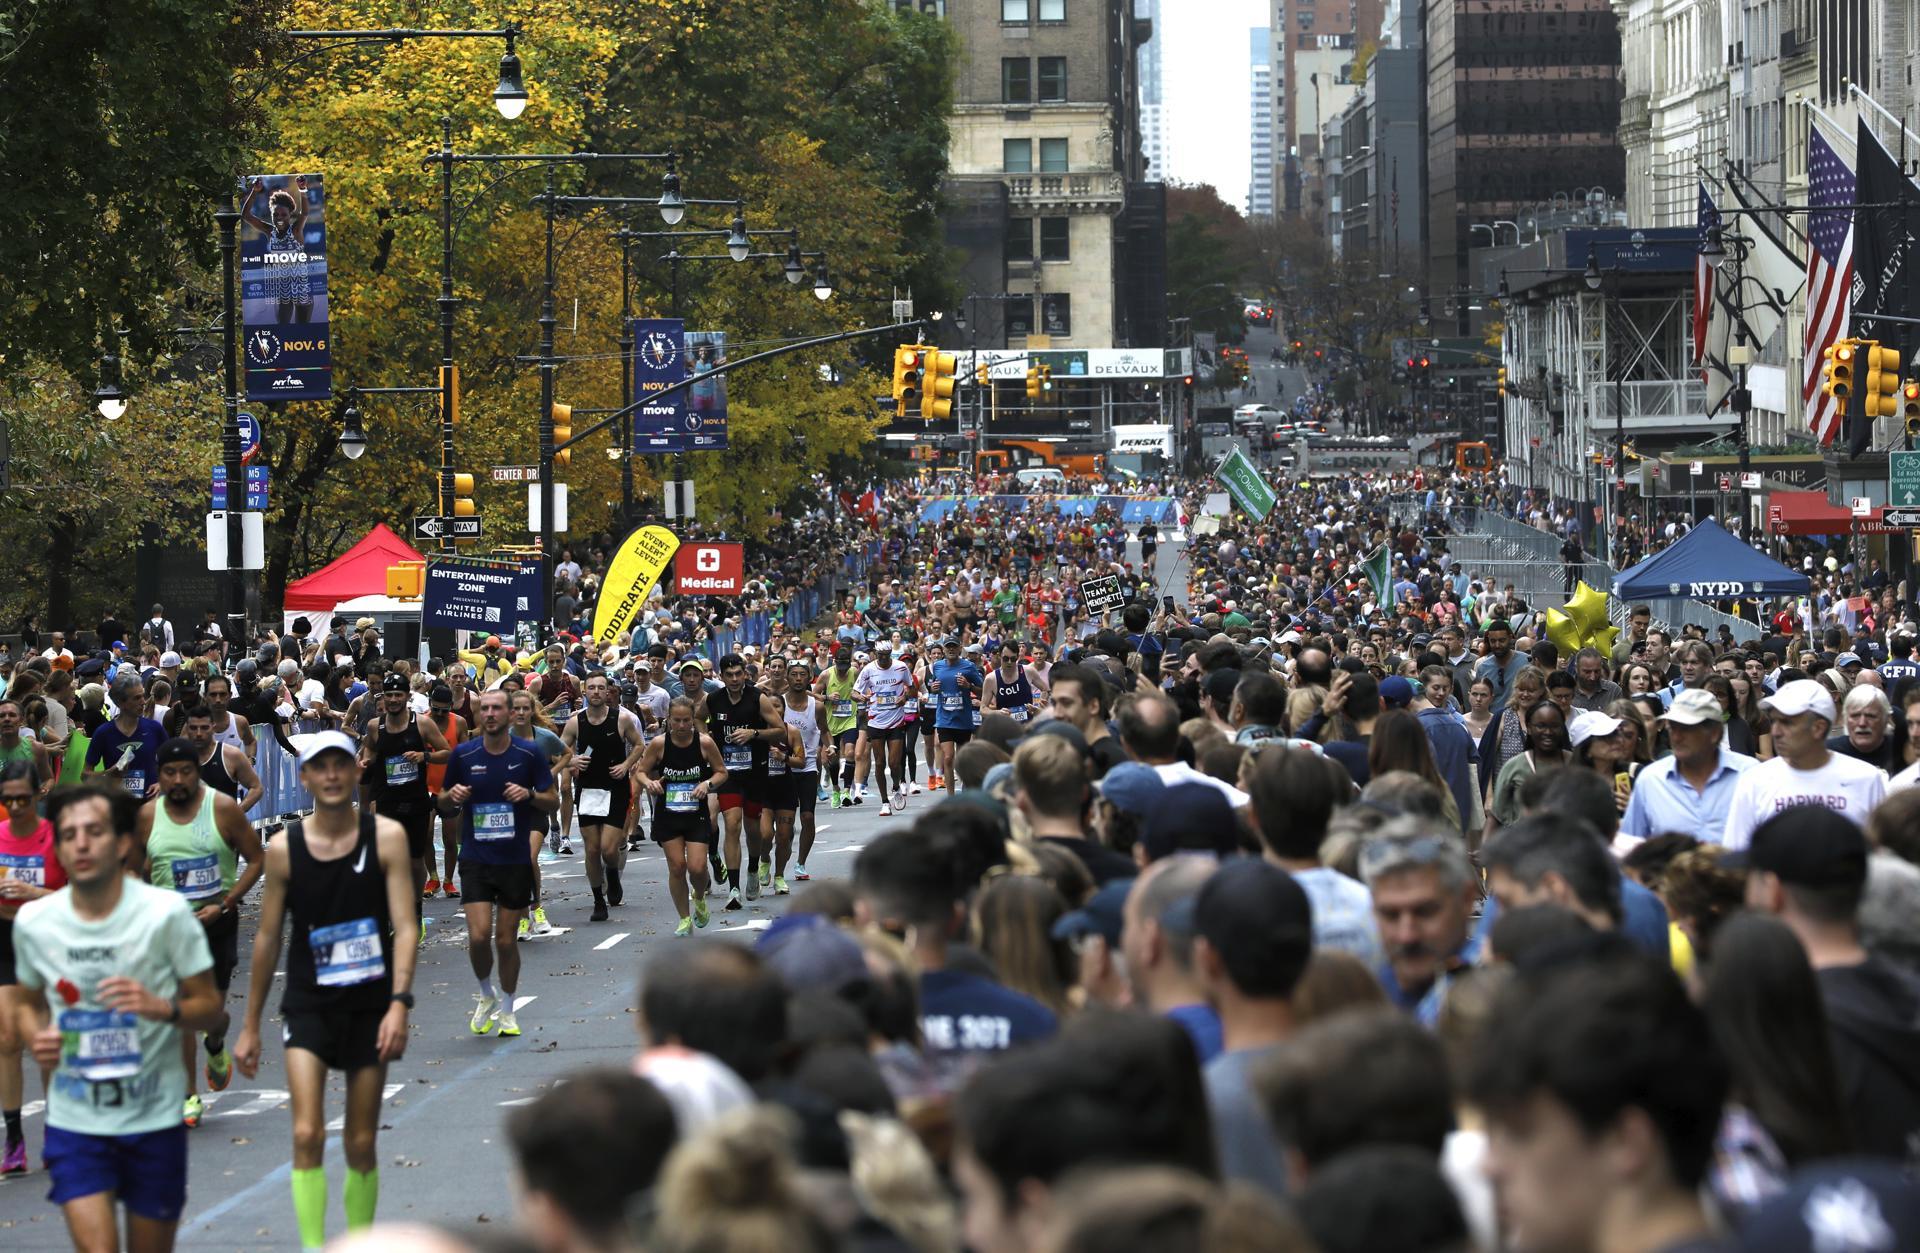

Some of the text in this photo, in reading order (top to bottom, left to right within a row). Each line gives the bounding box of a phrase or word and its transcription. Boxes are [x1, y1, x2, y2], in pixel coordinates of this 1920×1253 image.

[264, 252, 307, 263] move
[284, 340, 325, 351] NOV. 6
[1095, 366, 1158, 374] DELVAUX
[1120, 438, 1165, 446] PENSKE
[1333, 456, 1392, 468] DSNY
[248, 468, 260, 478] M5
[494, 469, 522, 480] CENTER
[248, 482, 260, 492] M5
[248, 496, 259, 506] M7
[428, 522, 474, 532] ONE WAY
[643, 531, 670, 551] EVENT
[638, 539, 665, 559] ALERT
[634, 547, 659, 568] LEVEL
[432, 569, 513, 584] ENTERTAINMENT
[458, 583, 485, 593] ZONE
[681, 578, 734, 589] Medical
[1690, 581, 1744, 596] NYPD
[1086, 587, 1107, 598] TEAM
[446, 604, 483, 613] UNITED
[436, 610, 482, 620] AIRLINES
[999, 684, 1020, 696] COLI
[663, 765, 700, 776] ROCKLAND
[490, 815, 509, 827] 6928
